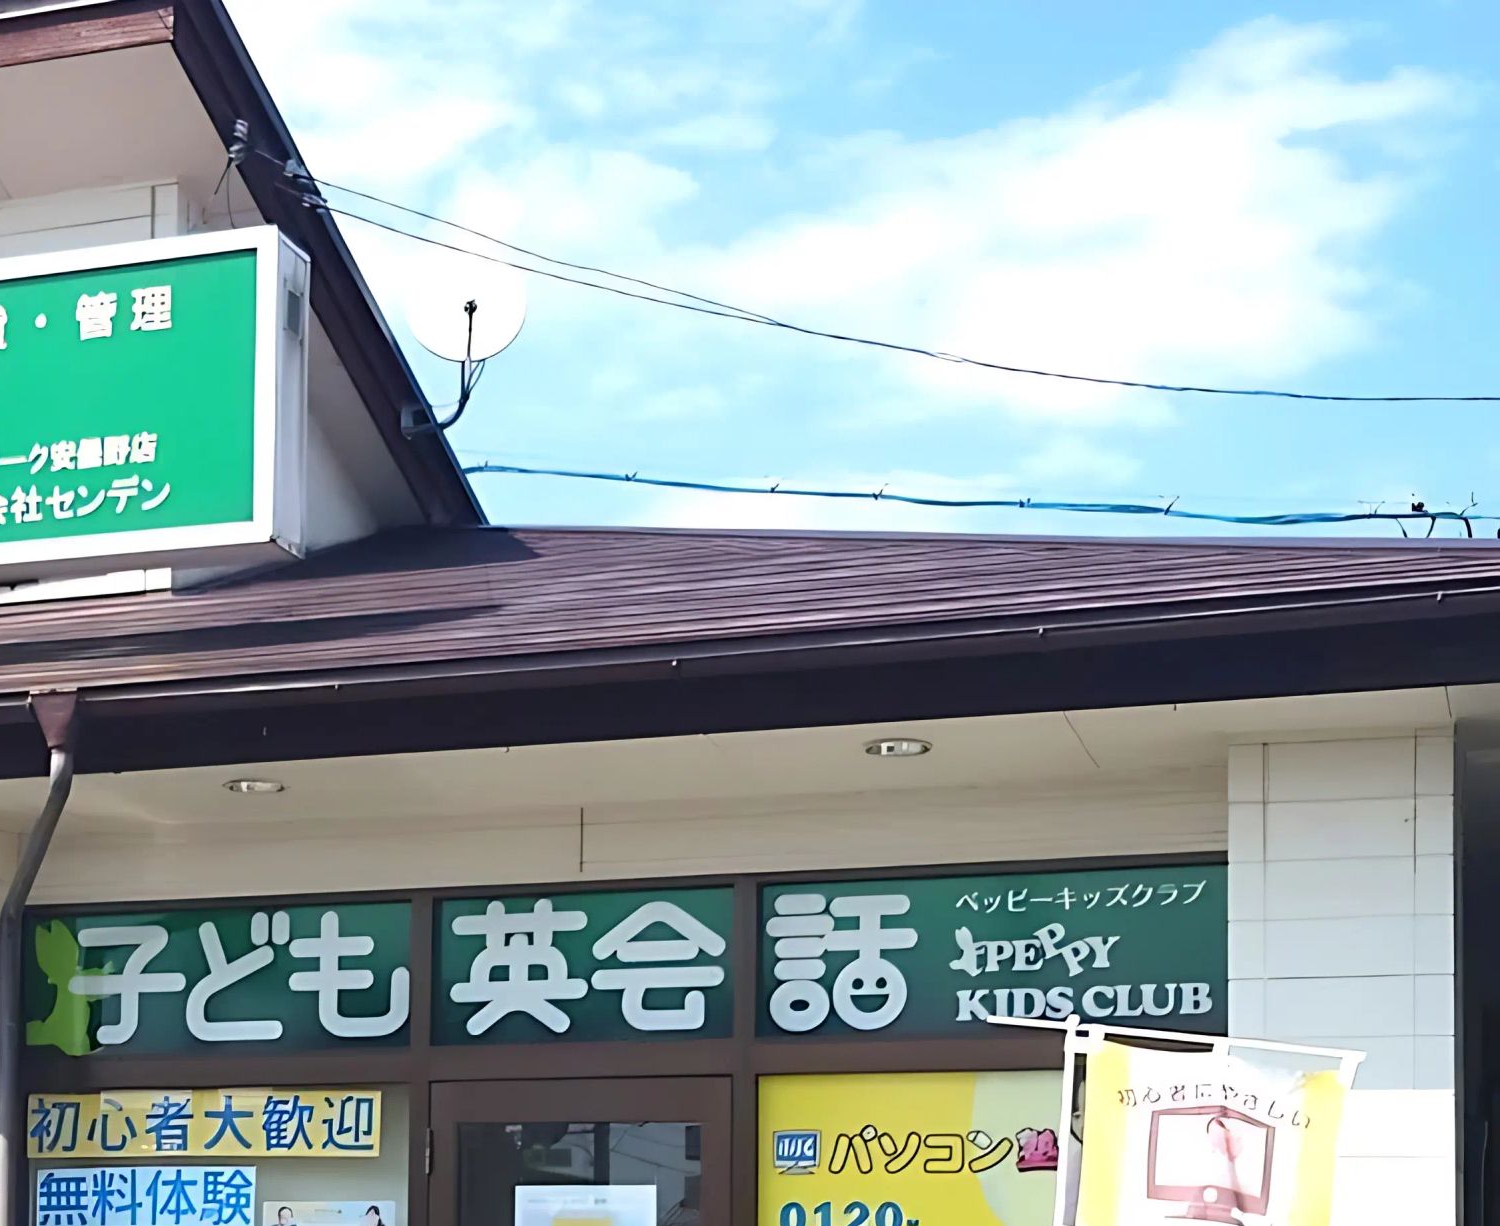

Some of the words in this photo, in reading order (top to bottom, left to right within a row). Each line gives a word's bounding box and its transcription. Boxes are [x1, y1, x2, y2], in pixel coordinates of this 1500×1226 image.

[984, 922, 1121, 977] PEPPY
[955, 986, 1075, 1022] KIDS
[1081, 982, 1213, 1017] CLUB
[29, 1095, 375, 1154] 初心者大歓迎
